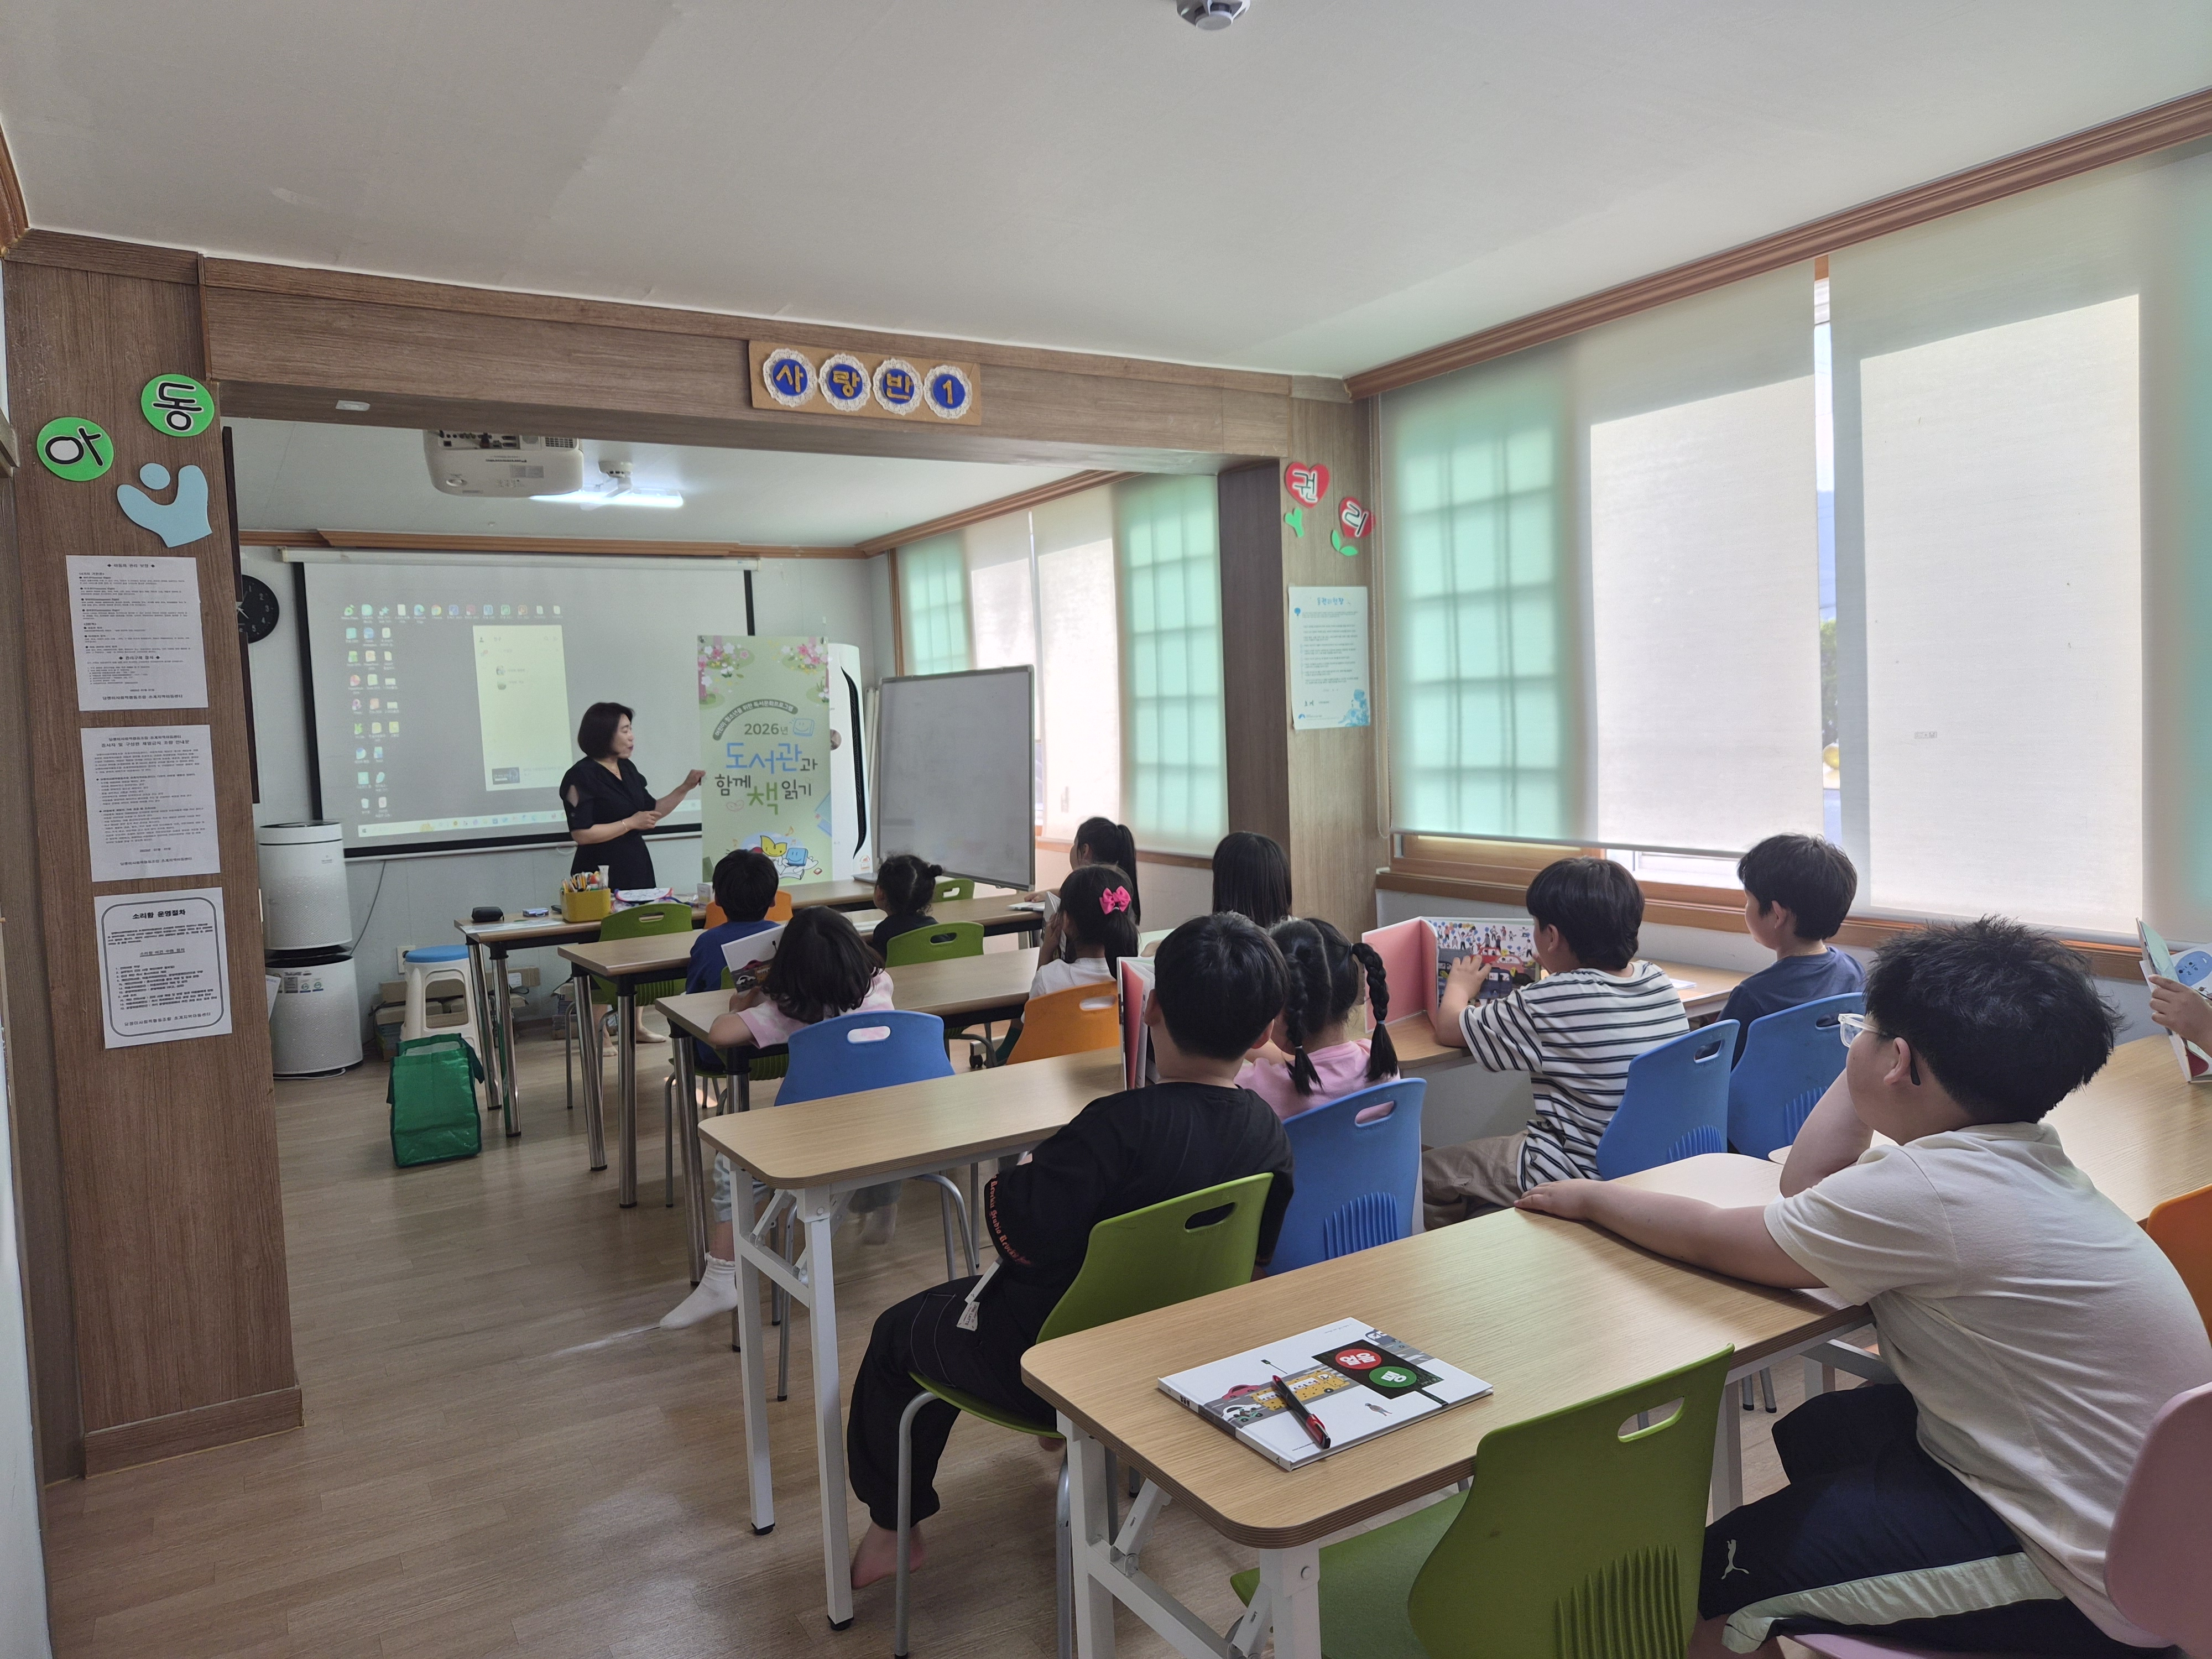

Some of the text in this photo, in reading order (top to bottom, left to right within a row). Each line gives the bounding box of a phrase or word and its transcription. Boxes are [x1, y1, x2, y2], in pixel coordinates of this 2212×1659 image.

[776, 365, 953, 404] 사랑반 1
[754, 700, 794, 712] 독서문화프로그램
[744, 723, 789, 735] 2026년
[714, 774, 812, 815] 함께 책 읽기
[132, 911, 154, 920] 소리함
[989, 1209, 1001, 1234] Studio
[1339, 1353, 1376, 1366] 얼음
[1381, 1370, 1407, 1383] 땡
